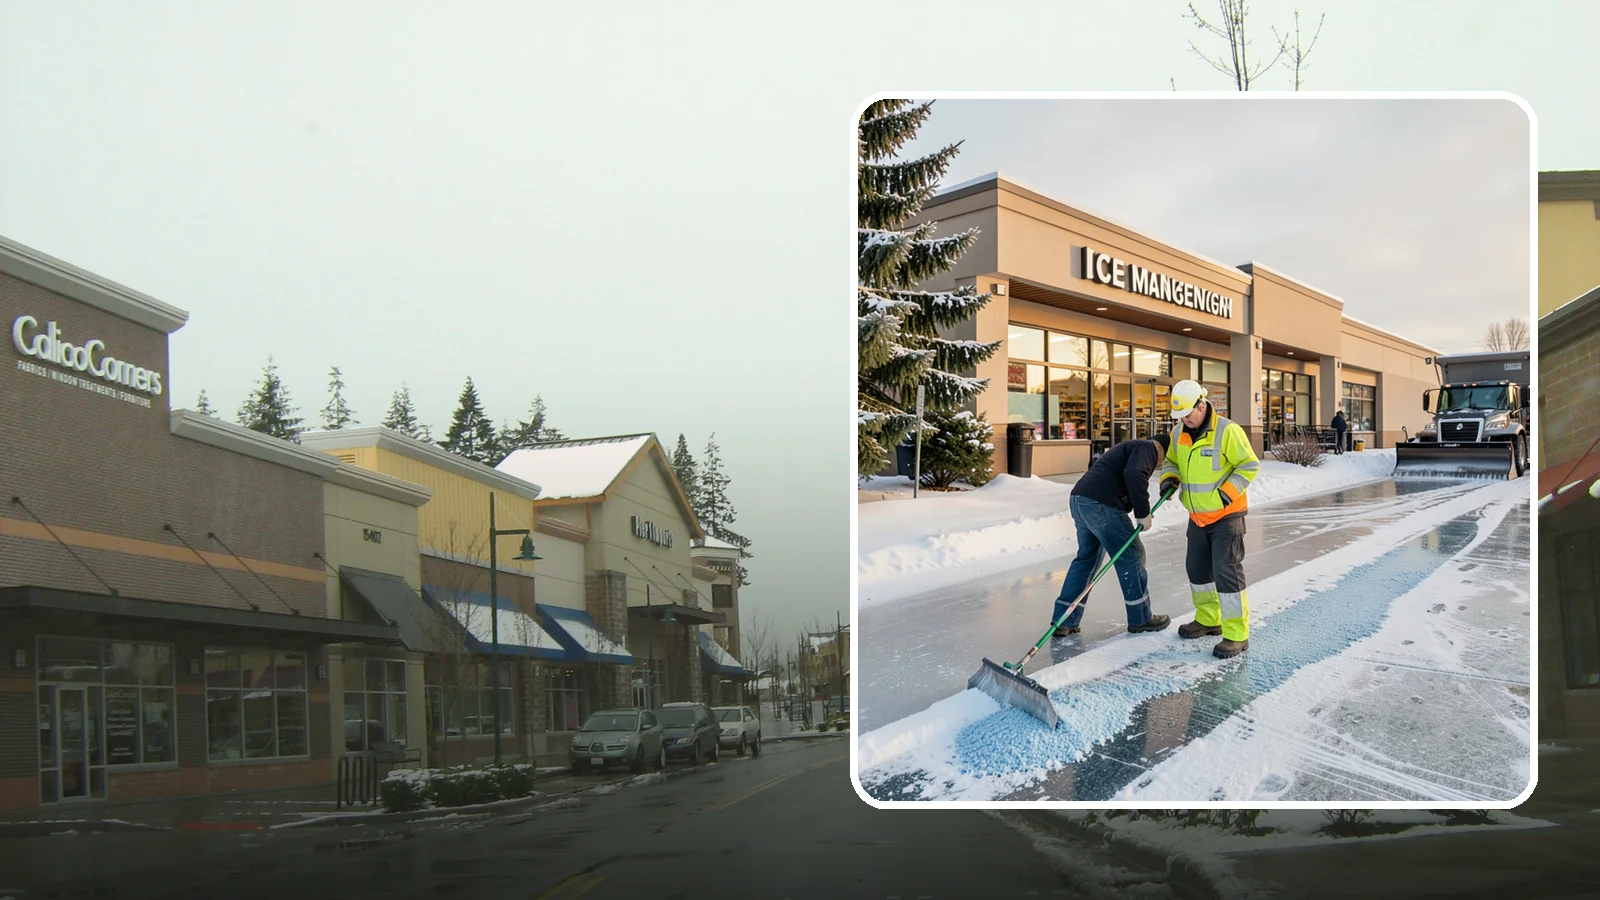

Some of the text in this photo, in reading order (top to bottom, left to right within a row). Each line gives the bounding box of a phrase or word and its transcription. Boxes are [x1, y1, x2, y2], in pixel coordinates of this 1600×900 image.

[1082, 246, 1125, 290] ICE
[17, 360, 47, 378] FABRICS
[51, 371, 78, 388] WINDOW
[78, 379, 117, 399] TREATMENTS
